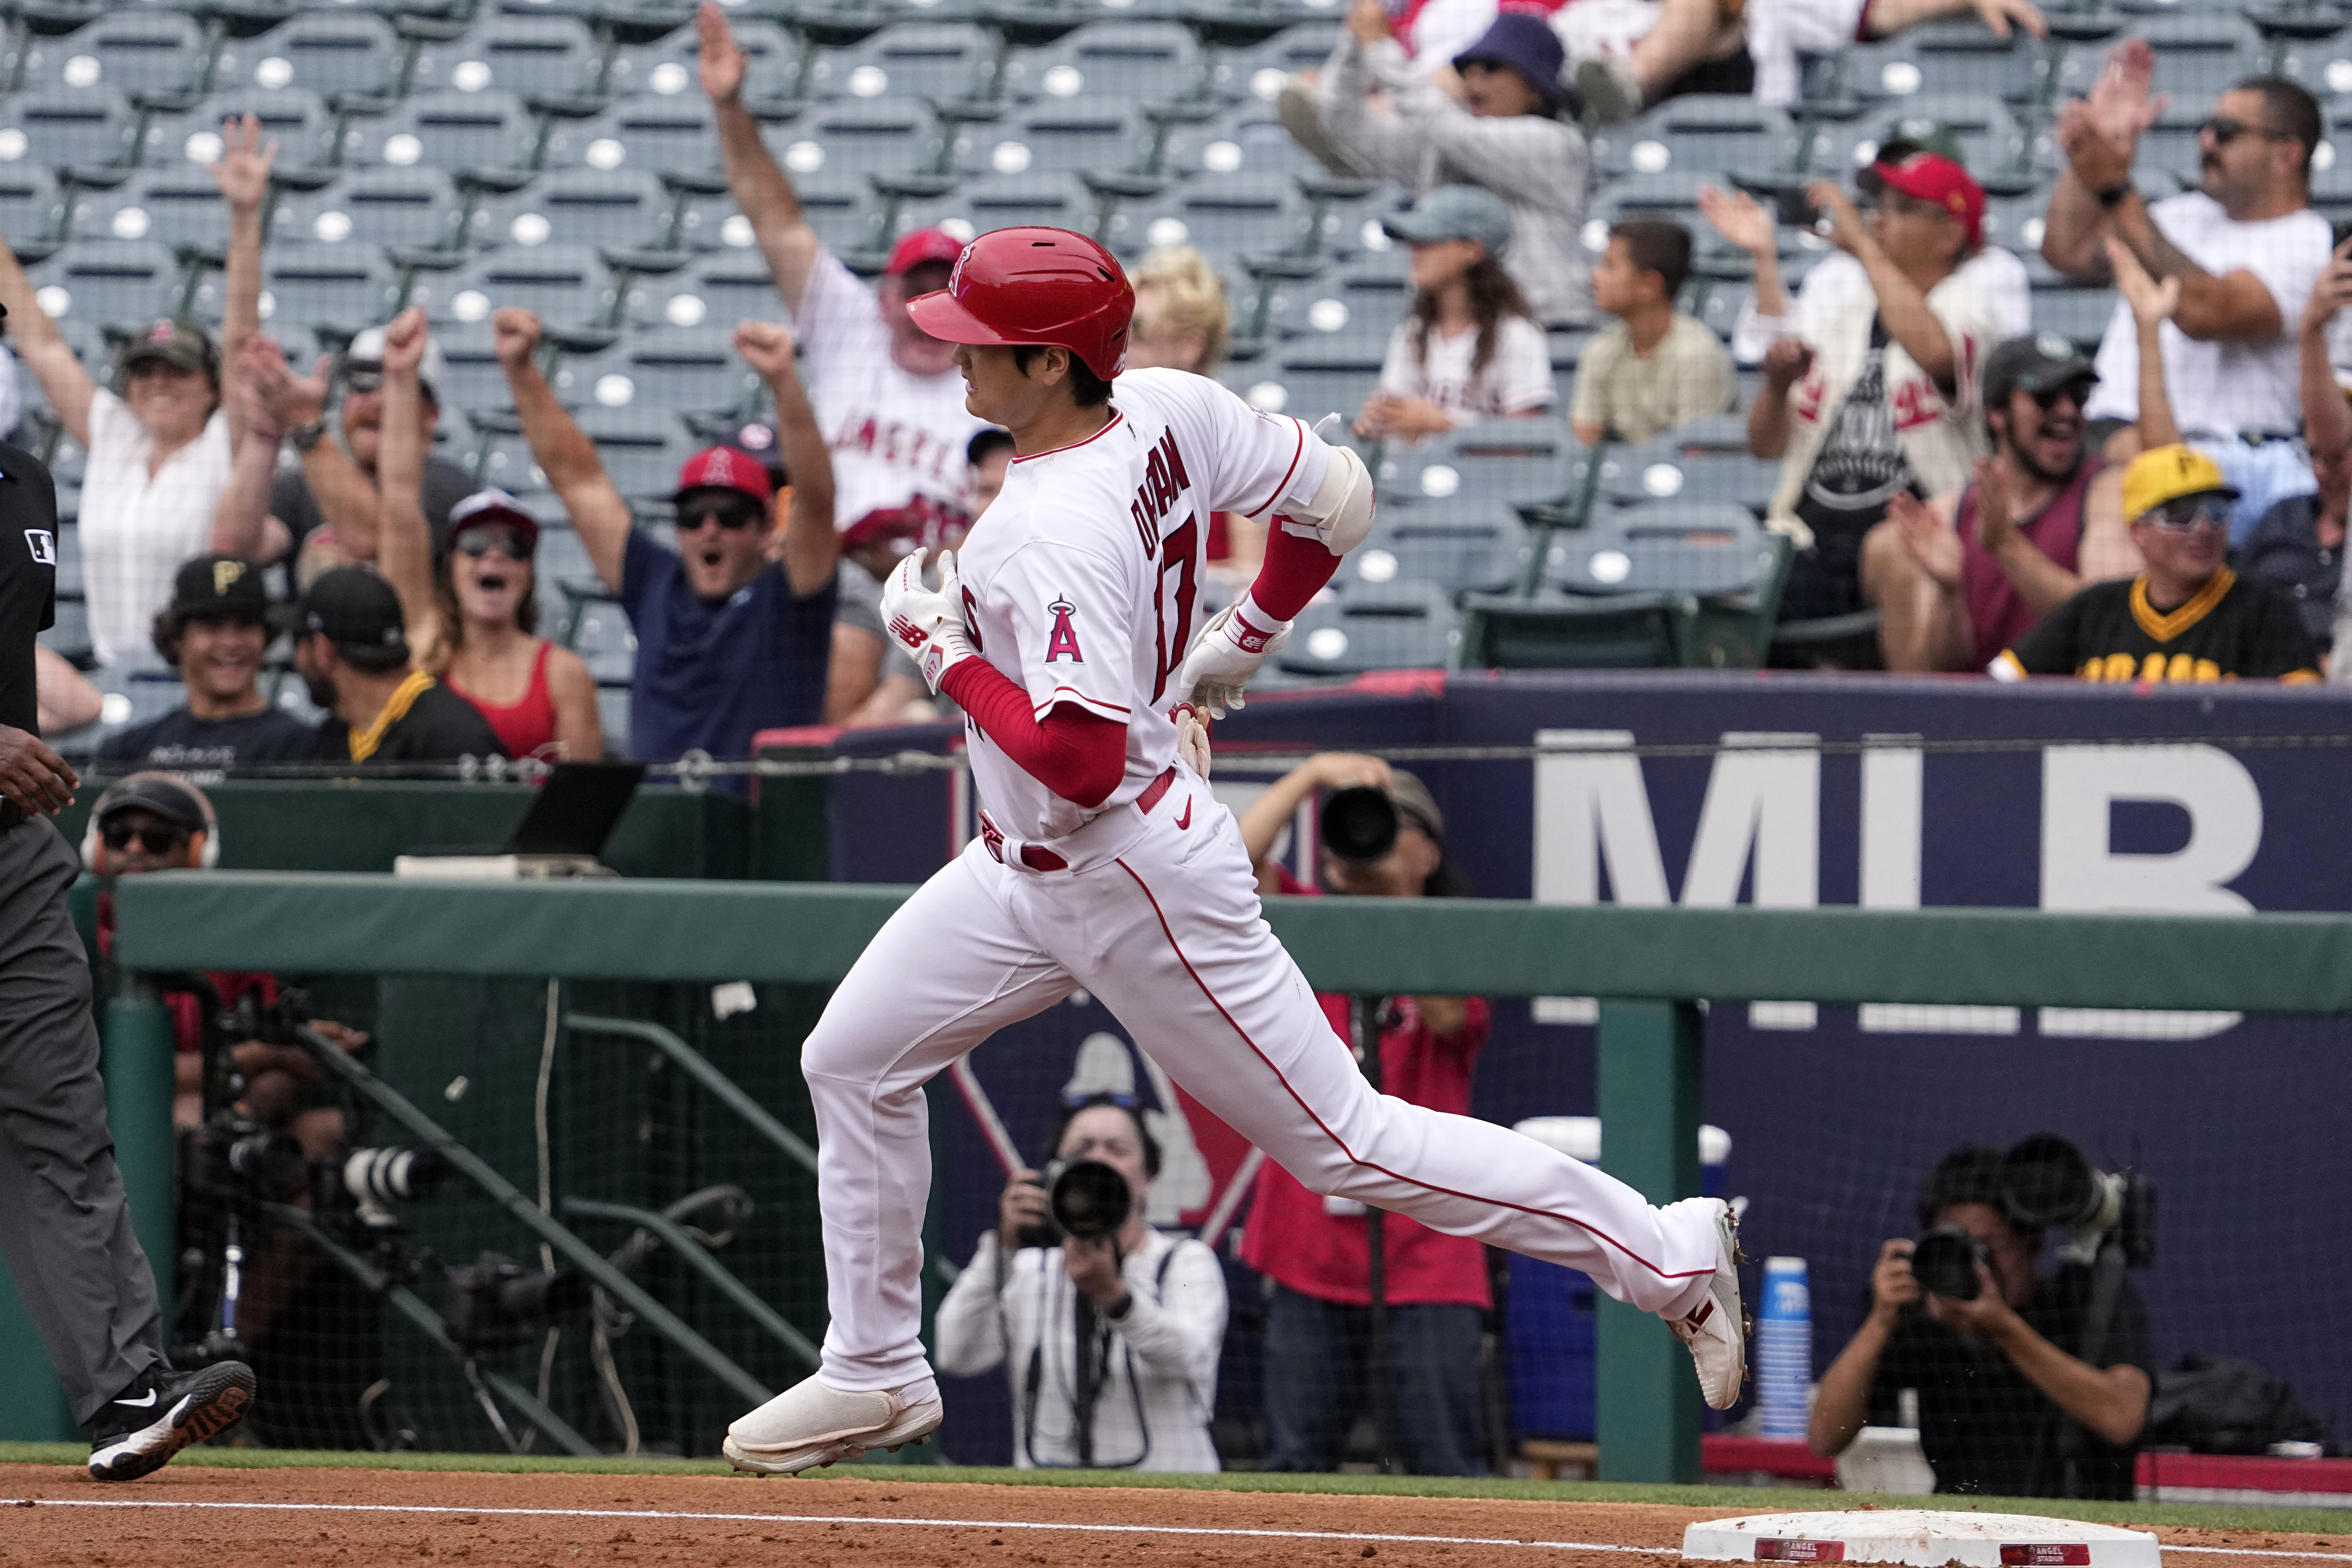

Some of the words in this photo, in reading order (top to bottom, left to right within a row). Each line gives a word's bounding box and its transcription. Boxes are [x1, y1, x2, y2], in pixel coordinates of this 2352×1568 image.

[1045, 593, 1084, 663] A
[1150, 509, 1197, 706] 17
[927, 659, 937, 680] 017
[1531, 728, 2264, 1041] MLB
[1790, 1543, 1817, 1551] ANGEL
